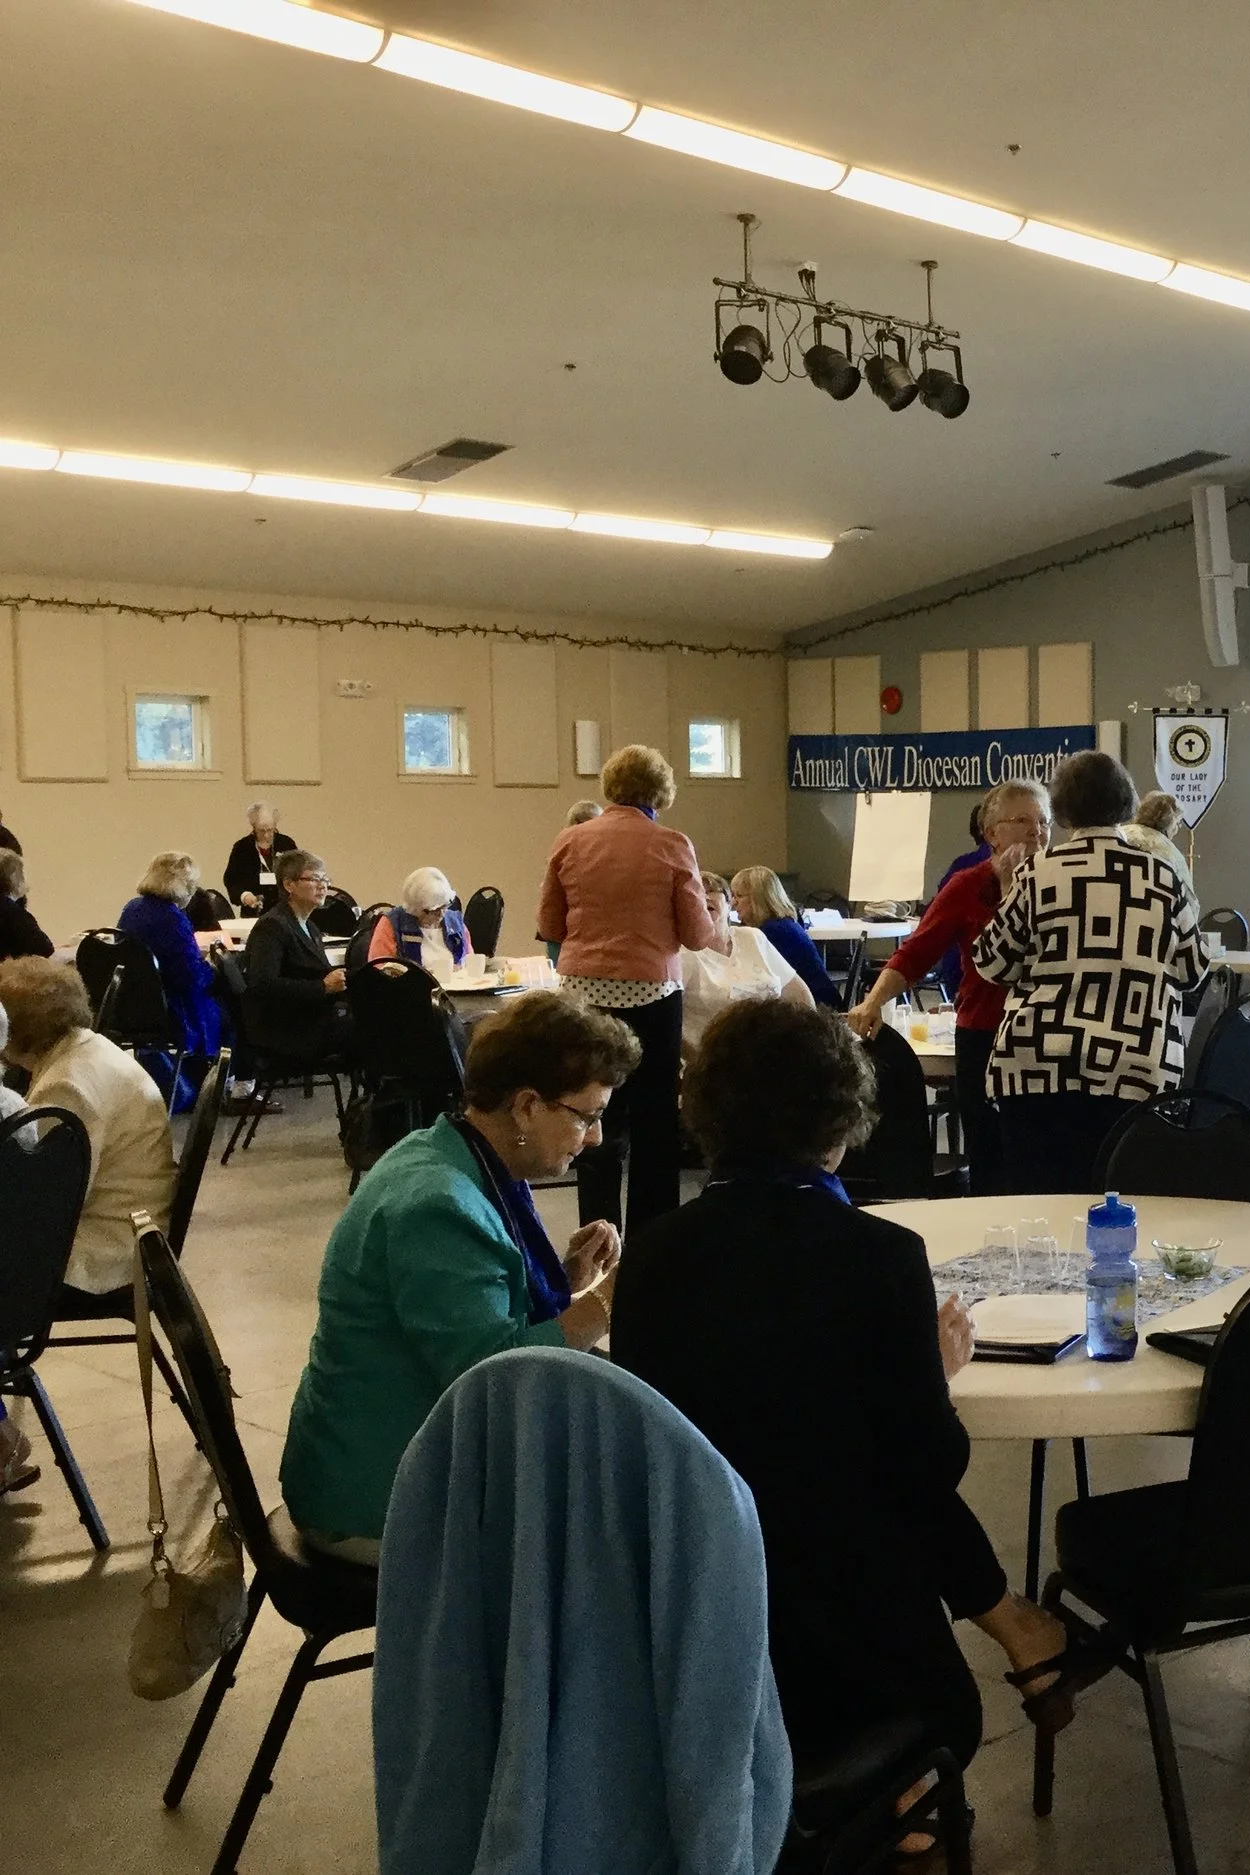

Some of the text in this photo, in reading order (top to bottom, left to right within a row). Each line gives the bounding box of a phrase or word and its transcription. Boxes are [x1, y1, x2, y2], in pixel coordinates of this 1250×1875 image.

[791, 738, 1073, 788] Annual CWL Diocesan Convent
[1170, 773, 1208, 781] OUR LADY
[1175, 784, 1201, 792] OF THE
